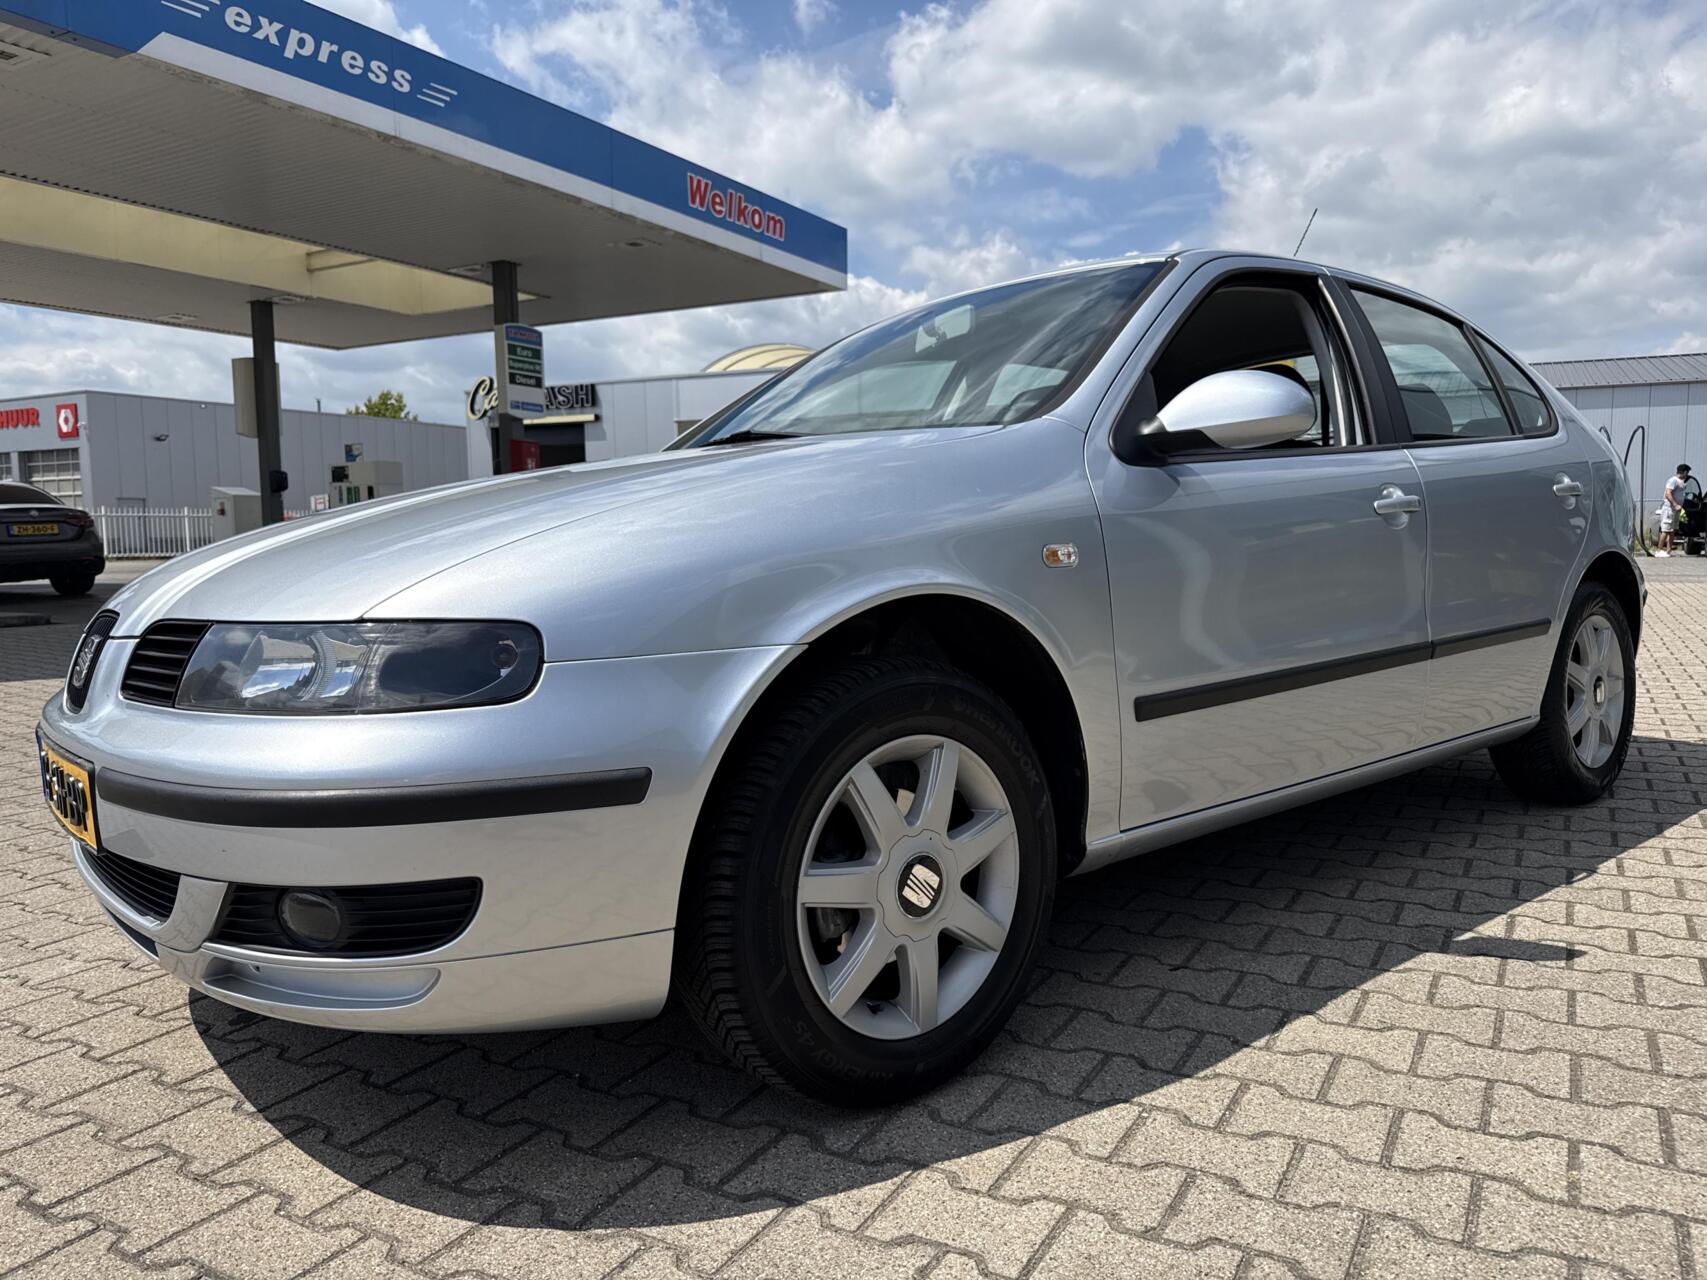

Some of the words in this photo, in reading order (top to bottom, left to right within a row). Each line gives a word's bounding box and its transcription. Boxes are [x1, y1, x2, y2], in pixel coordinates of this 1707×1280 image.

[224, 6, 412, 93] express
[688, 172, 785, 241] Welkom
[516, 347, 532, 358] Euro
[467, 376, 498, 420] Ca
[545, 384, 597, 409] ASH
[516, 374, 536, 386] Diesel
